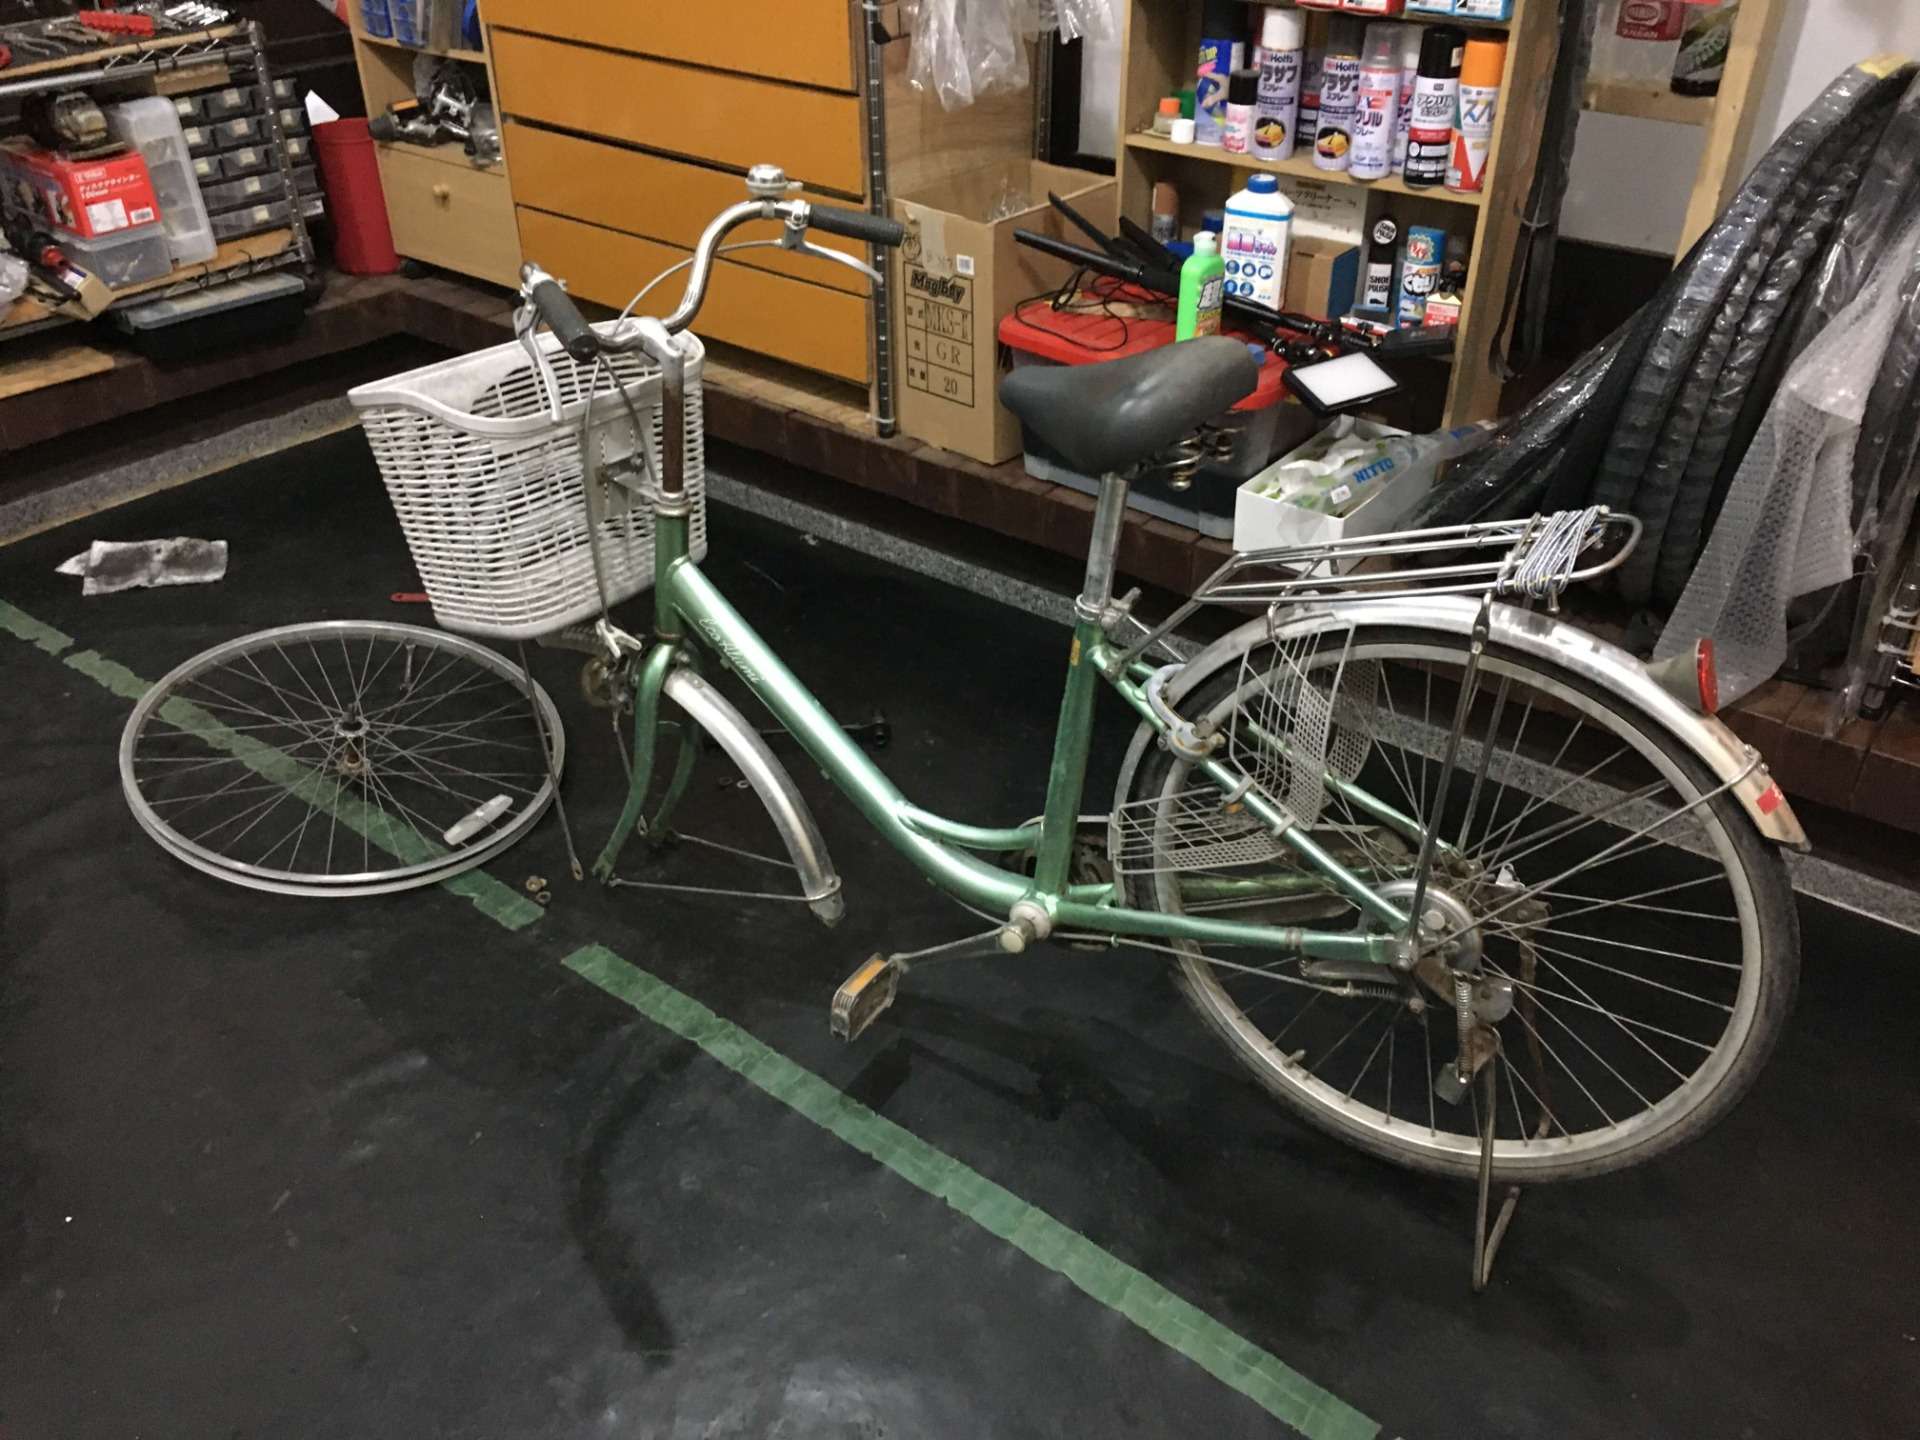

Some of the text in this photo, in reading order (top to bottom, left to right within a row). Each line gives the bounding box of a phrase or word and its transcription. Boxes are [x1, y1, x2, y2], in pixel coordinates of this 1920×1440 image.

[1270, 54, 1293, 63] Holts
[1369, 275, 1389, 284] SHOE
[1368, 284, 1389, 293] POLISH
[943, 375, 958, 395] 20
[1353, 459, 1393, 482] NITTO
